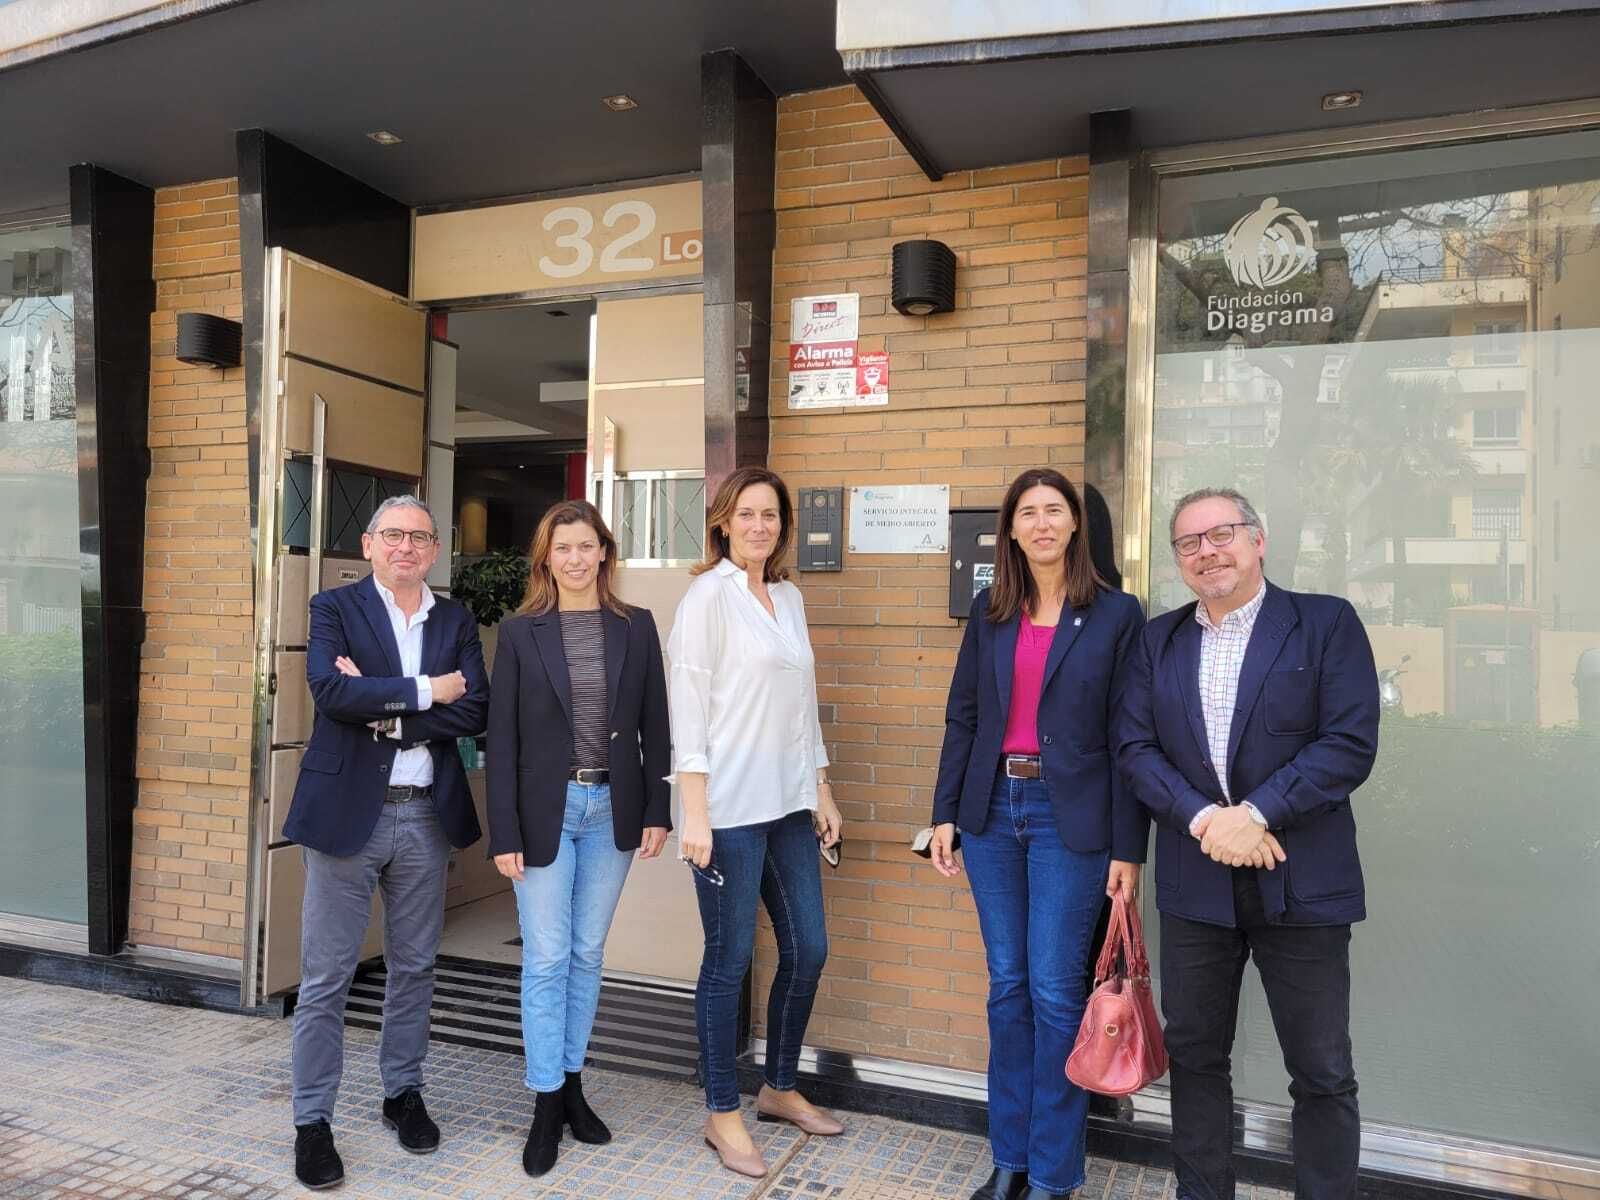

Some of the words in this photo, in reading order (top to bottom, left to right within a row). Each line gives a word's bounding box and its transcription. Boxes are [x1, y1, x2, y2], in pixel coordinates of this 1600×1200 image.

[539, 201, 656, 278] 32
[1208, 290, 1303, 310] Fundación
[1207, 306, 1333, 333] Diagrama
[794, 346, 854, 361] Alarma
[863, 507, 898, 515] SERVICIO
[900, 507, 937, 515] INTEGRAL
[865, 520, 875, 528] DE
[876, 520, 901, 528] MEDIO
[902, 520, 937, 528] ABIERTO
